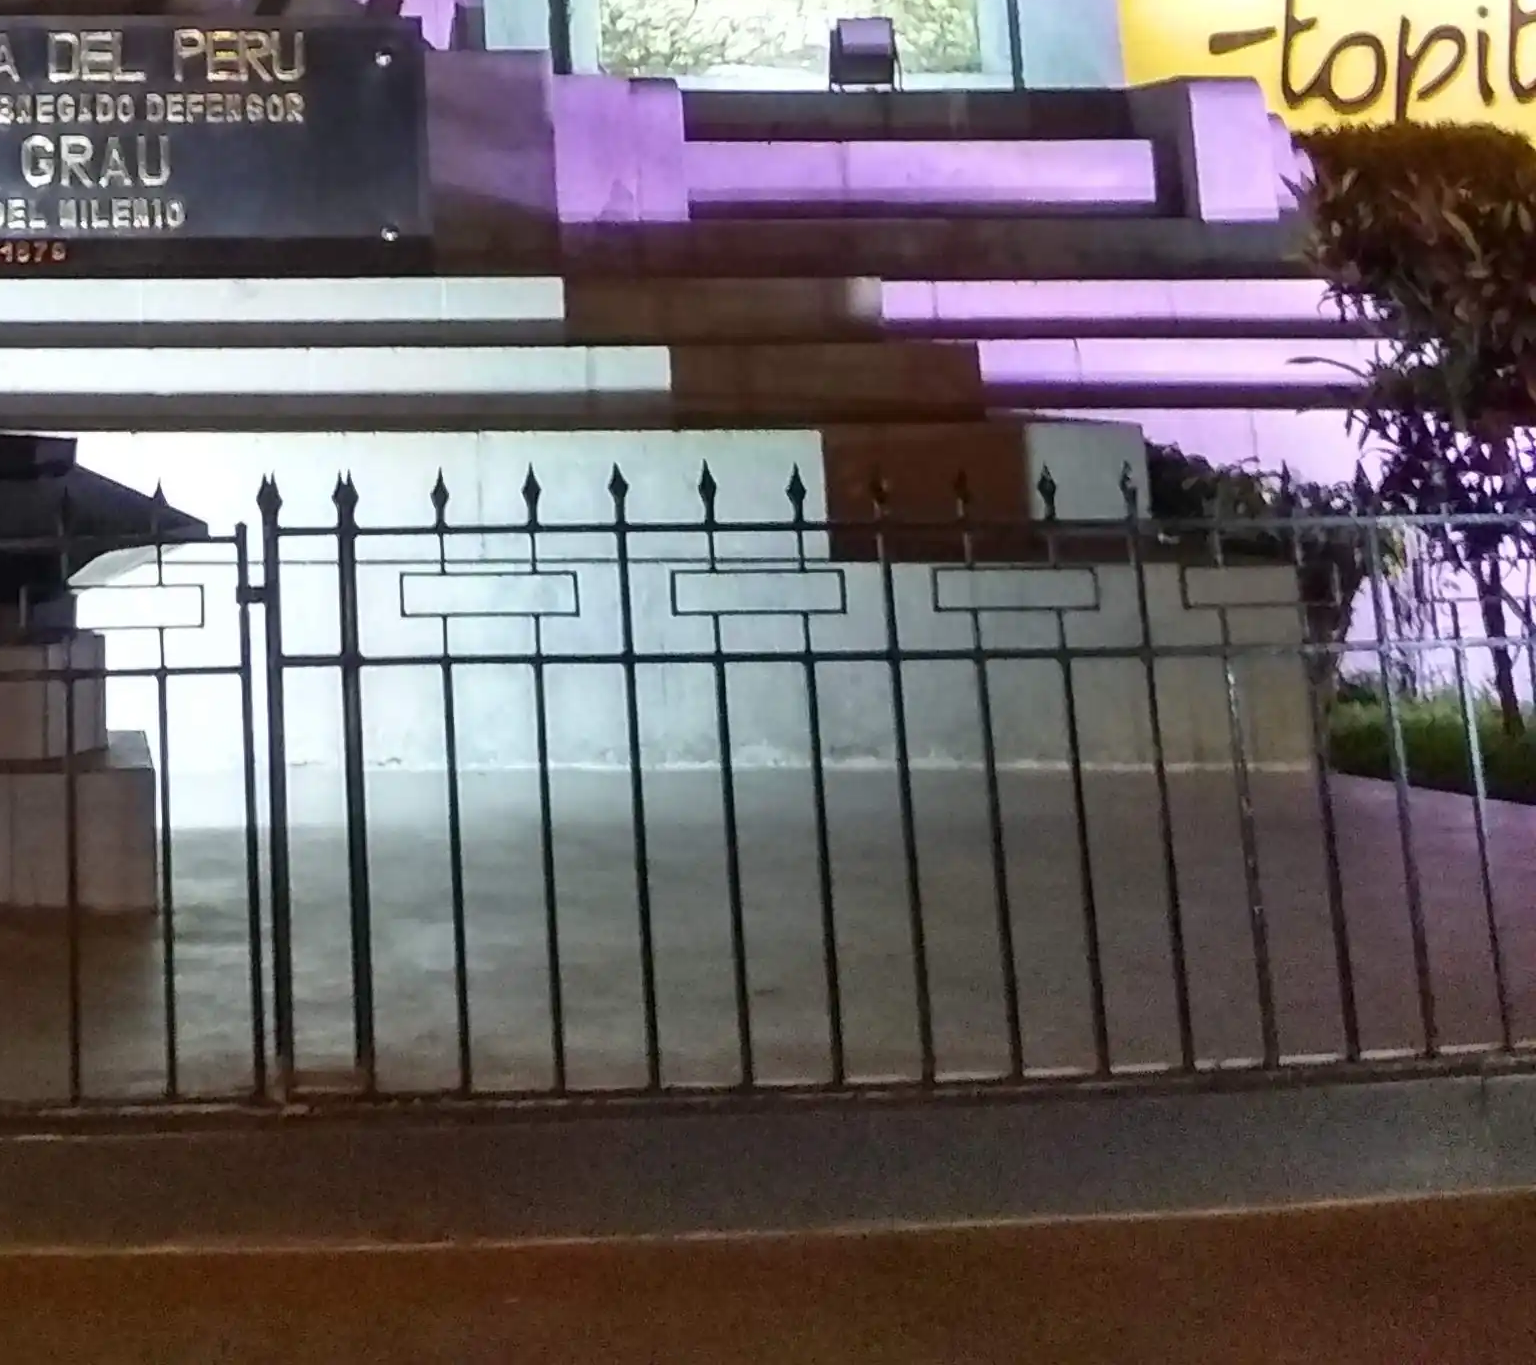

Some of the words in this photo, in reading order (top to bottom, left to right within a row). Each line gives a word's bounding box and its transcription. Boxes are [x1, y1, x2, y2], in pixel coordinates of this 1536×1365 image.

[47, 29, 147, 82] DEL
[173, 28, 306, 82] PERU
[145, 93, 305, 124] DEFENSOR
[20, 134, 171, 188] GRAU
[58, 198, 186, 229] MILENIO
